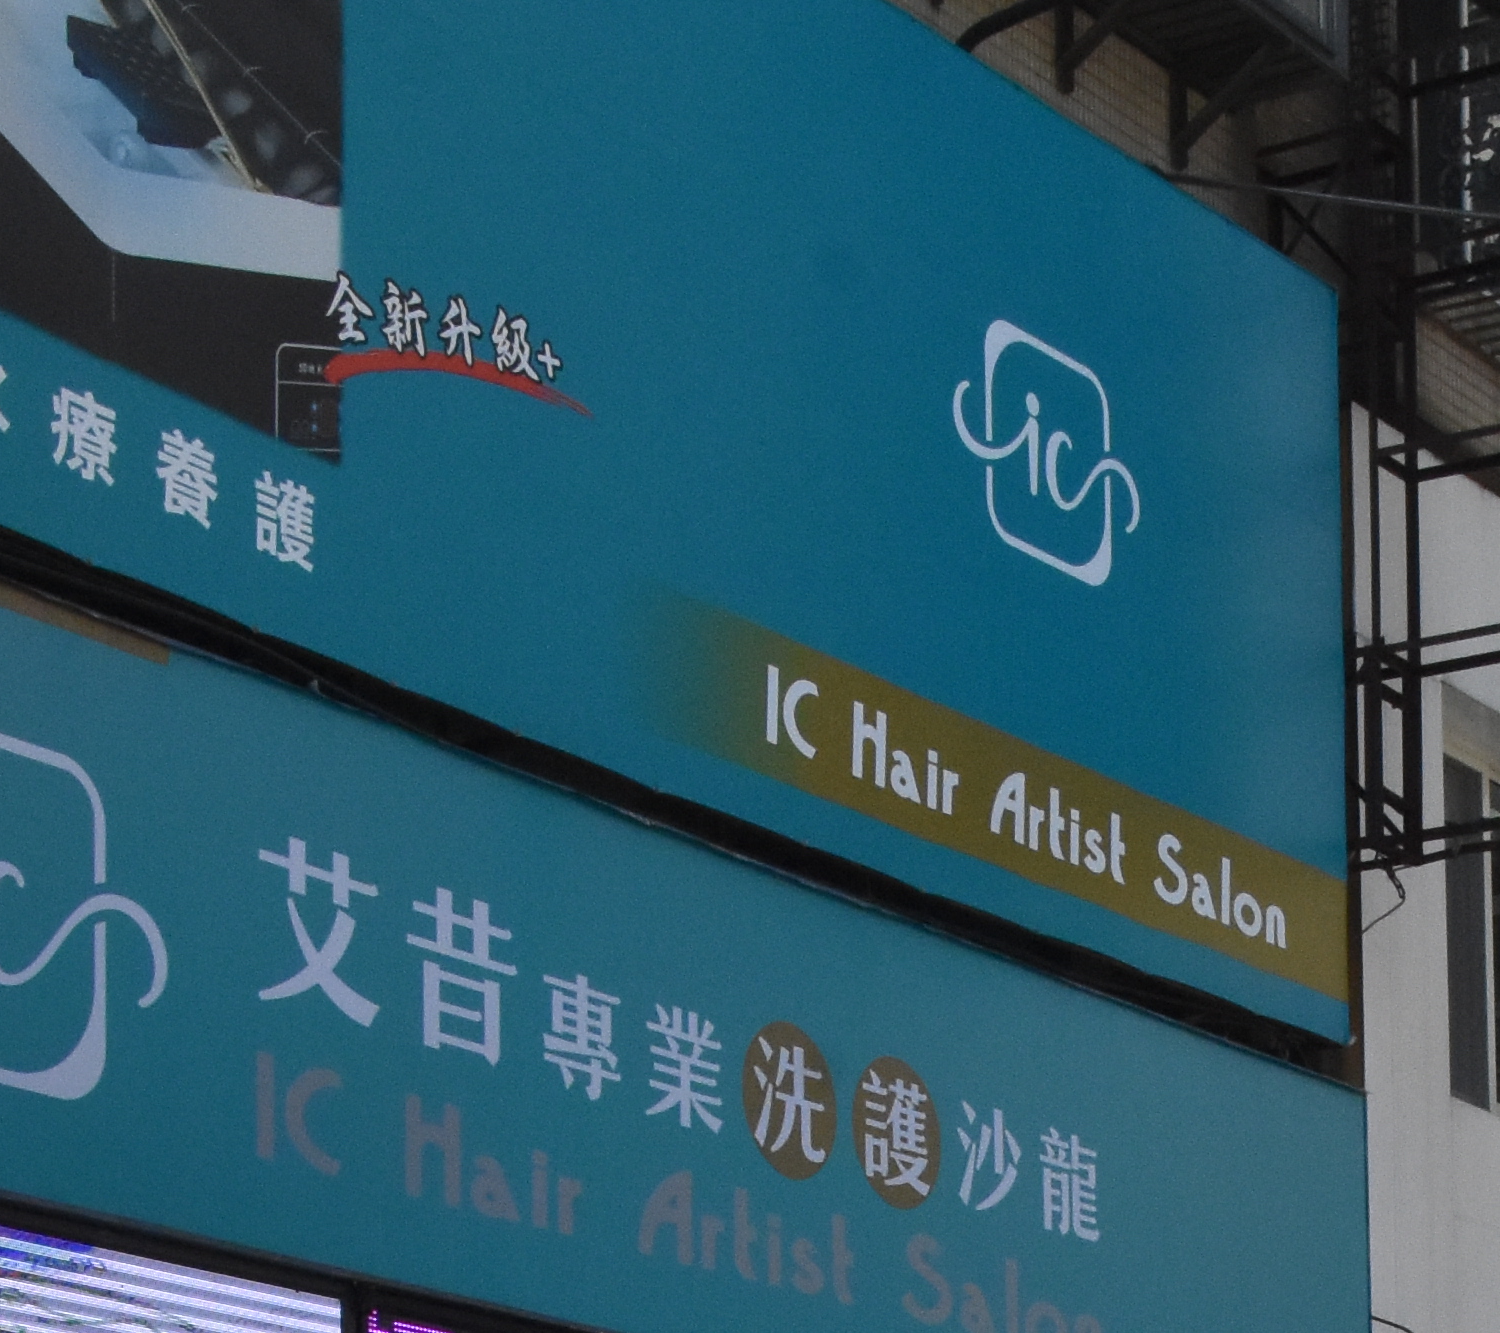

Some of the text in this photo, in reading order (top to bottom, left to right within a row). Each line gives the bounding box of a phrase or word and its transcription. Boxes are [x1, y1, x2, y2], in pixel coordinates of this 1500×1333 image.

[765, 664, 1287, 948] IC Hair Artist Salon
[255, 1049, 342, 1176] IC
[404, 1095, 583, 1238] Hair
[638, 1168, 856, 1307] Artist
[258, 834, 1101, 1243] 艾昔專業洗護沙龍
